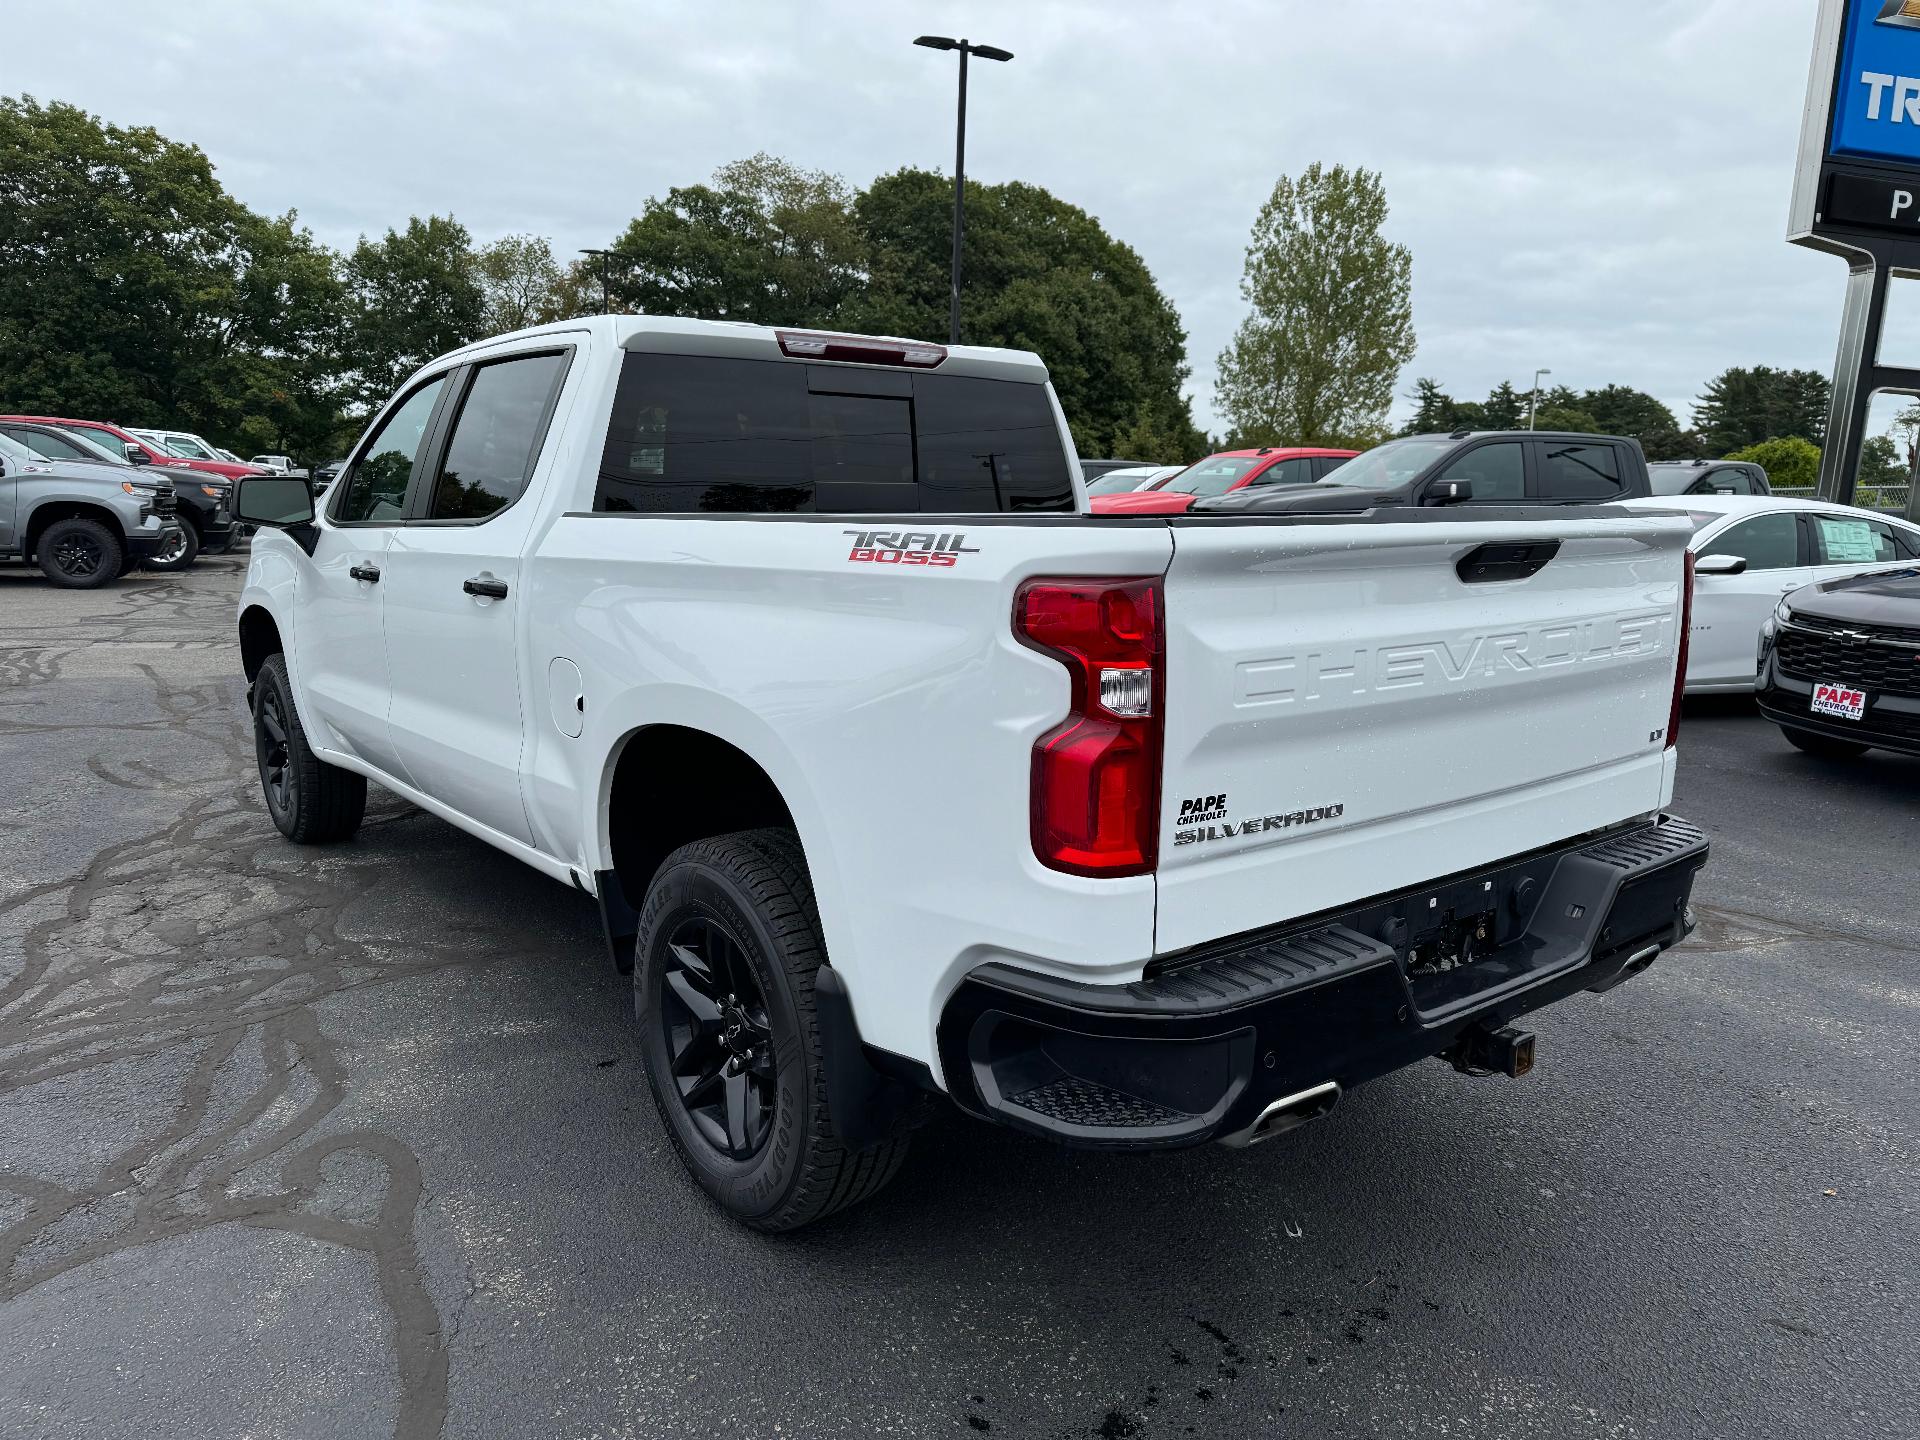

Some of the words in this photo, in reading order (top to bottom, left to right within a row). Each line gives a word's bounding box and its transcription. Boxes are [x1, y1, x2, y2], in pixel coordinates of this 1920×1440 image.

[843, 530, 981, 552] TRAIL
[848, 548, 959, 567] BOSS
[1233, 612, 1673, 708] CHEVROLET
[1816, 687, 1862, 706] PAPE
[1813, 699, 1862, 714] CHEVROLET
[1649, 728, 1665, 743] LT
[1179, 793, 1227, 816] PAPE
[1173, 803, 1344, 847] SILVERADO
[1176, 809, 1228, 826] CHEVROLET
